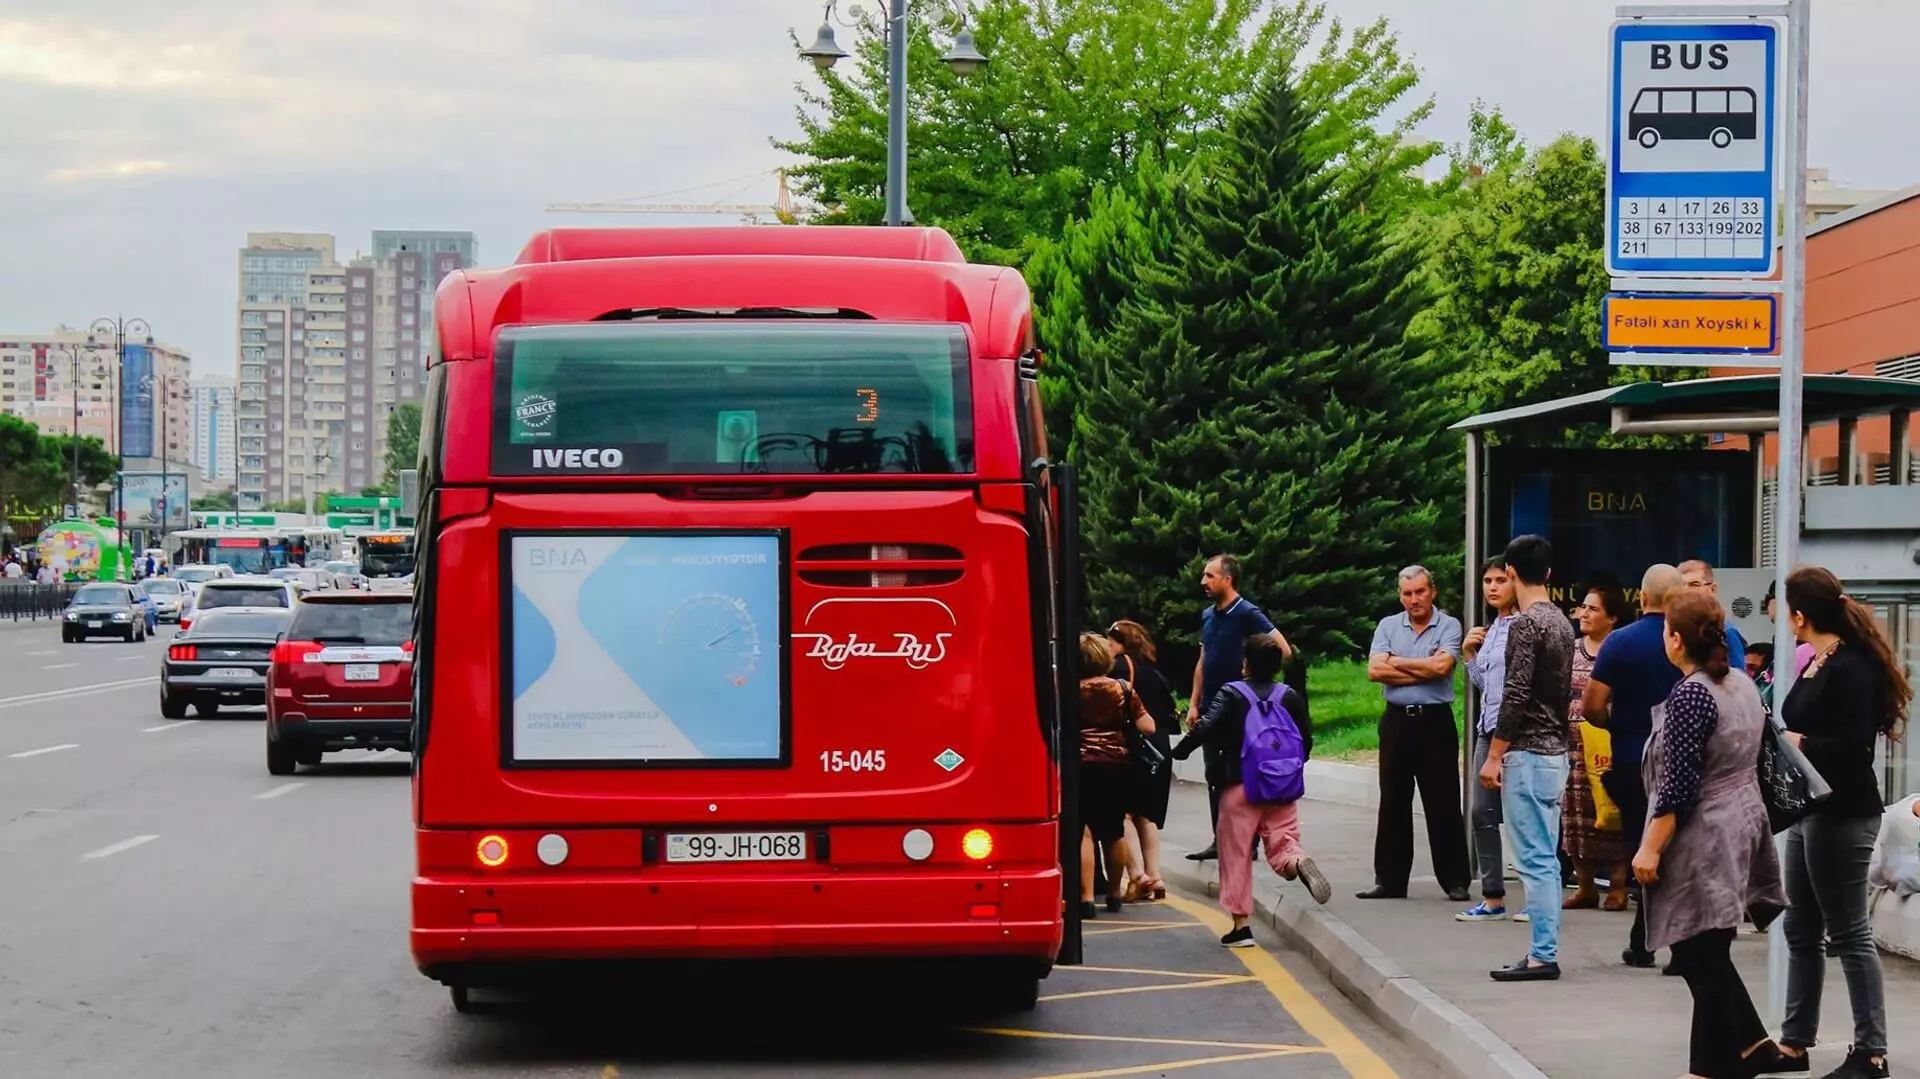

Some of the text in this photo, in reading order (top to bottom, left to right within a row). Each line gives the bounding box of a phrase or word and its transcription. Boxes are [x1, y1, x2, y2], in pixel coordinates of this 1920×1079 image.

[1650, 43, 1729, 70] BUS
[1630, 201, 1759, 215] 3 4 17 26 33
[1623, 221, 1763, 235] 38 67 133 199 202
[1622, 241, 1646, 254] 211
[1614, 314, 1657, 328] Fətəli
[1662, 317, 1690, 329] xan
[1695, 316, 1748, 332] Xoyski
[856, 389, 877, 421] 3
[532, 448, 623, 469] IVECO
[1588, 492, 1646, 511] BNA
[530, 547, 588, 566] BNA
[793, 633, 953, 664] Baku Bus
[819, 749, 887, 773] 15-045
[688, 835, 801, 858] 99-JH-068
